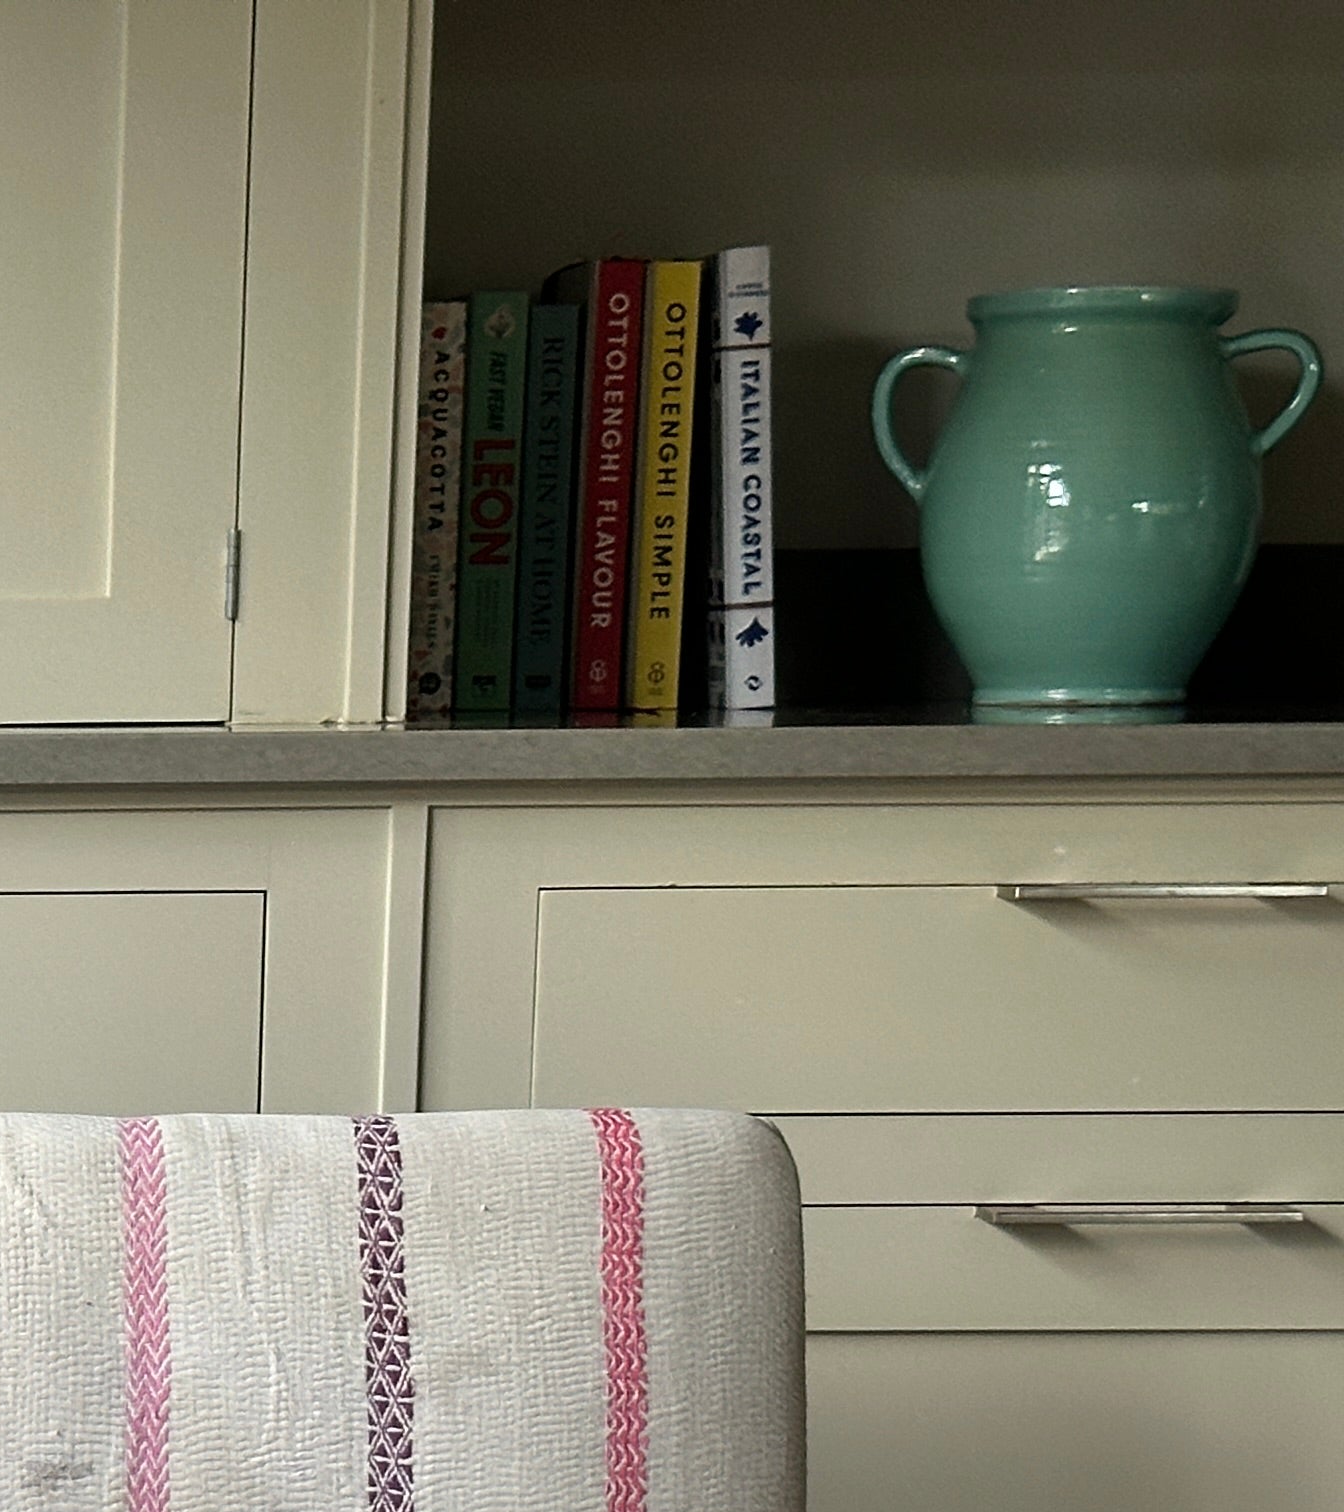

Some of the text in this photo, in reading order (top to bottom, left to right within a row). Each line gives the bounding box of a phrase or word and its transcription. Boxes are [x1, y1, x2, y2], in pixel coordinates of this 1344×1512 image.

[427, 351, 450, 531] ACQUACOTTA
[470, 440, 513, 564] LEON
[487, 351, 507, 431] FAST VEGAN
[529, 337, 566, 648] RICK STEIN AT HOME
[590, 293, 628, 627] OTTOLENGHI FLAVOUR
[650, 302, 686, 620] OTTOLENGHI SIMPLE
[739, 360, 762, 596] ITALIAN COASTAL
